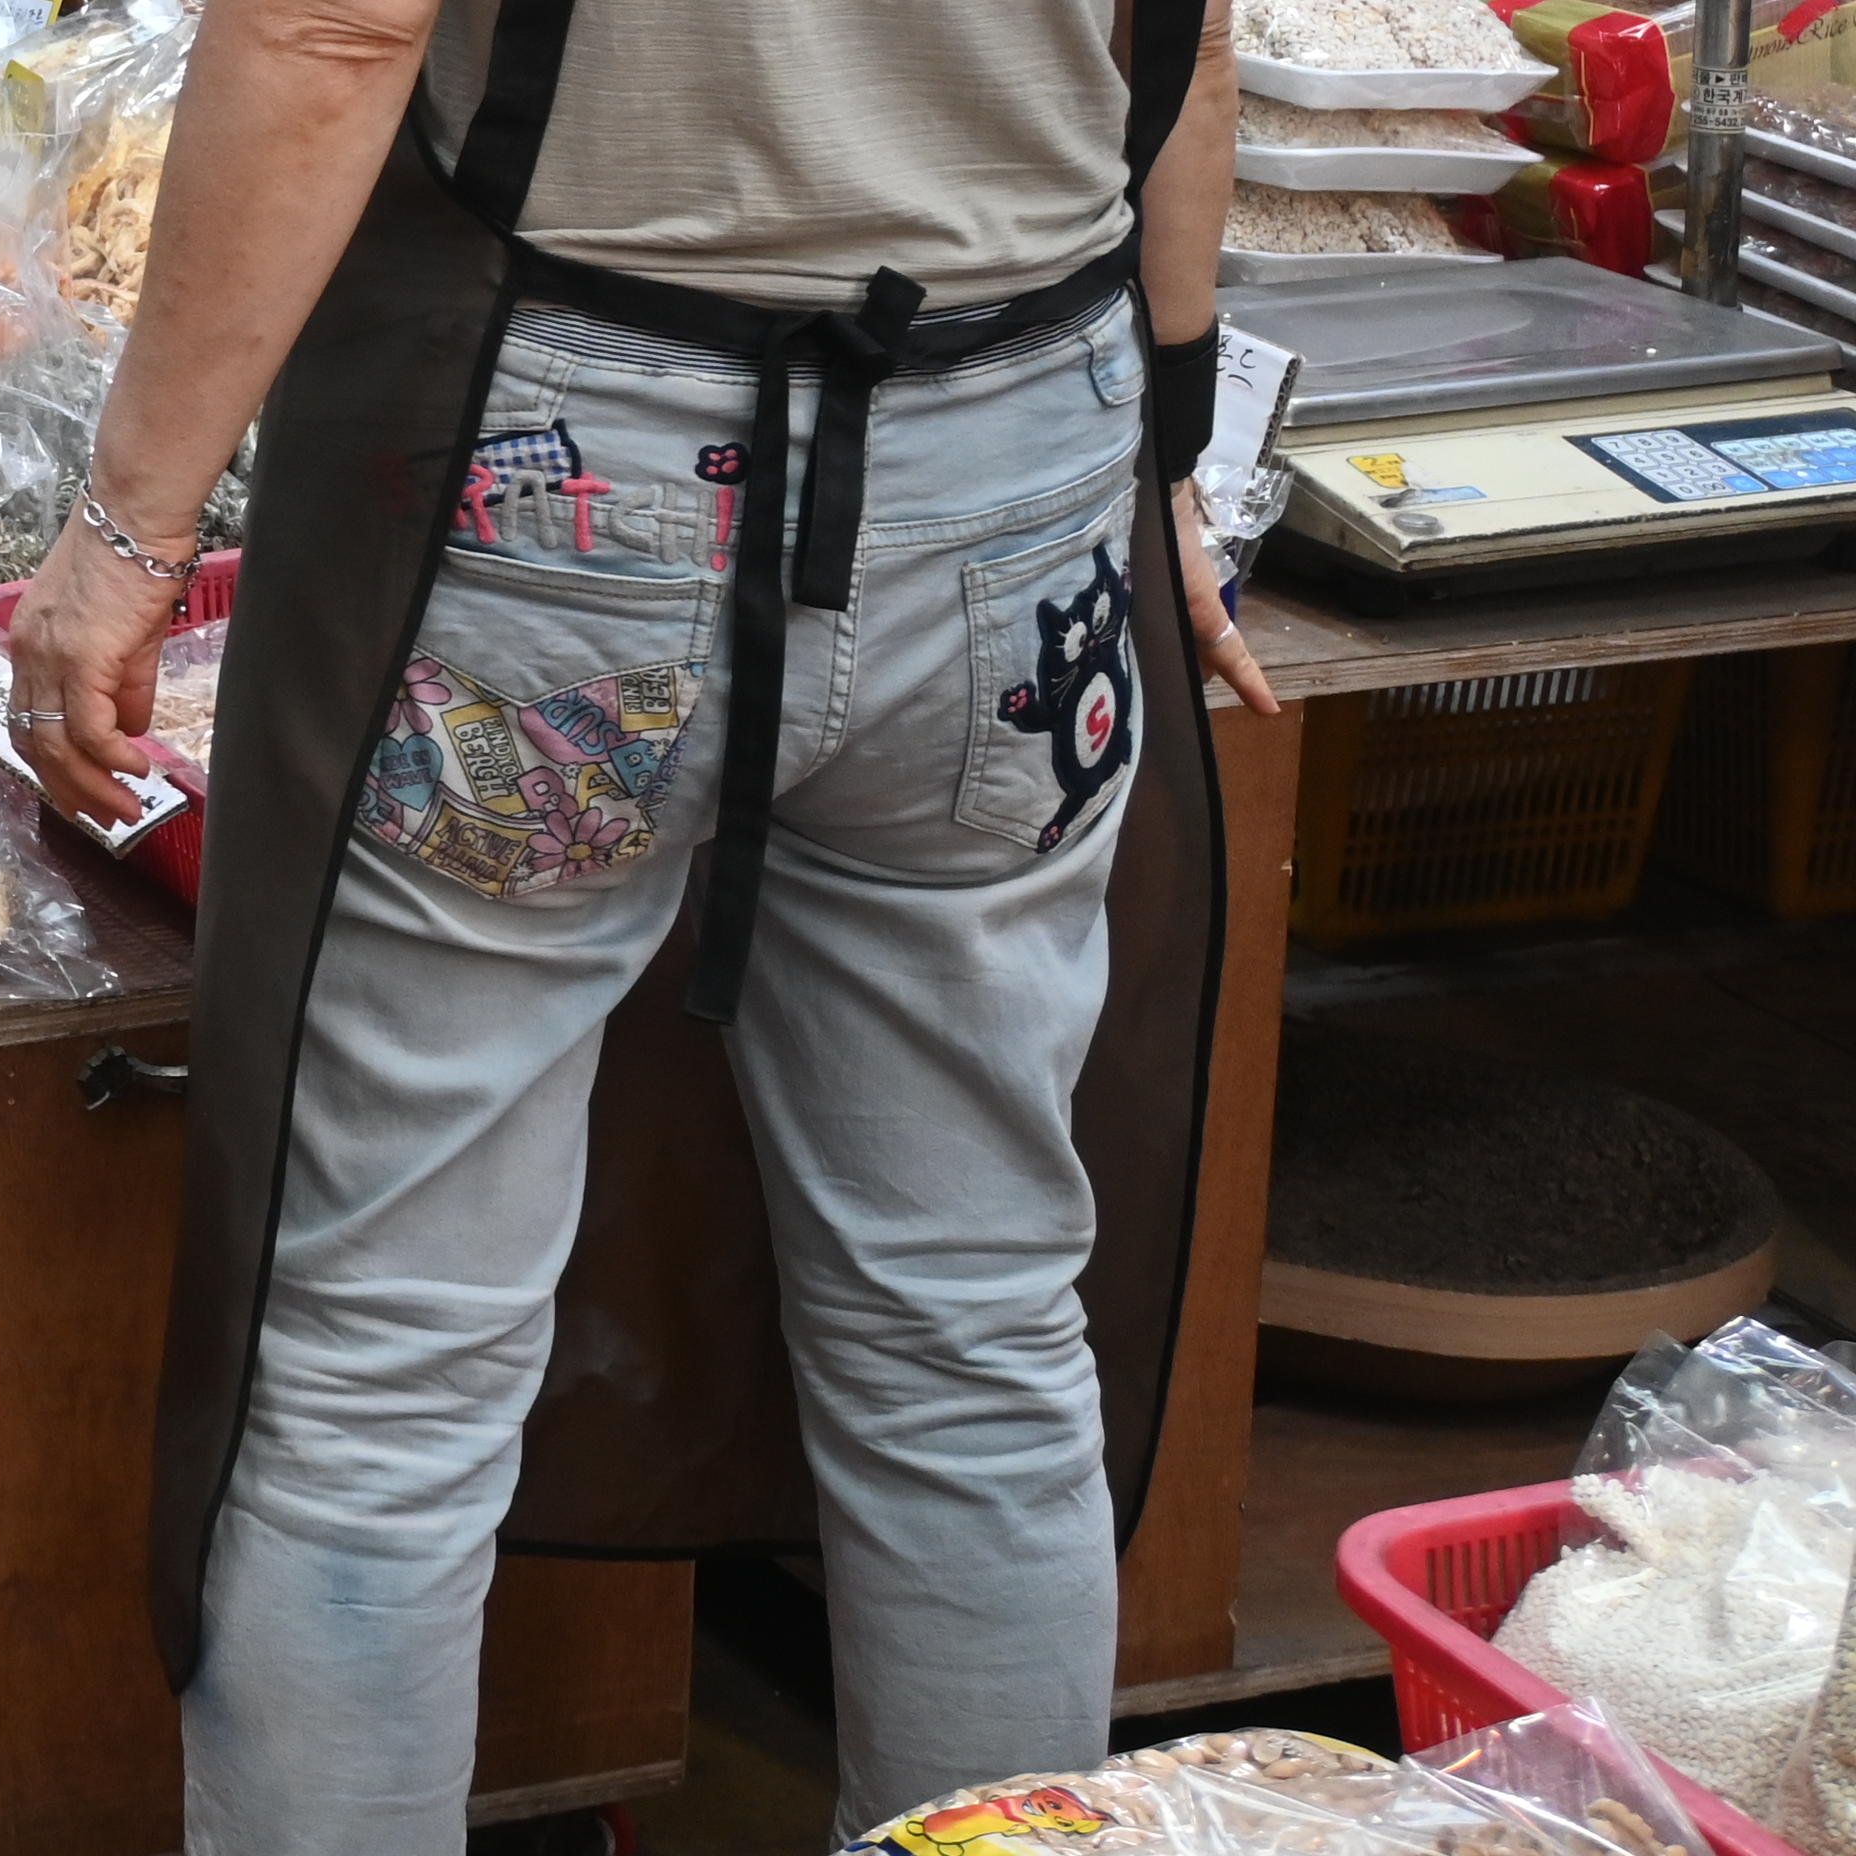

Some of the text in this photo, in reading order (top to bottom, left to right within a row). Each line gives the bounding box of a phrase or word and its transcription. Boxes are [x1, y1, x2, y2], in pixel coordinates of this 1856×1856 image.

[1703, 89, 1747, 104] 한국계
[640, 668, 672, 714] BEA
[536, 689, 627, 756] SUR
[1086, 695, 1111, 751] S
[435, 816, 522, 866] ACTIVE
